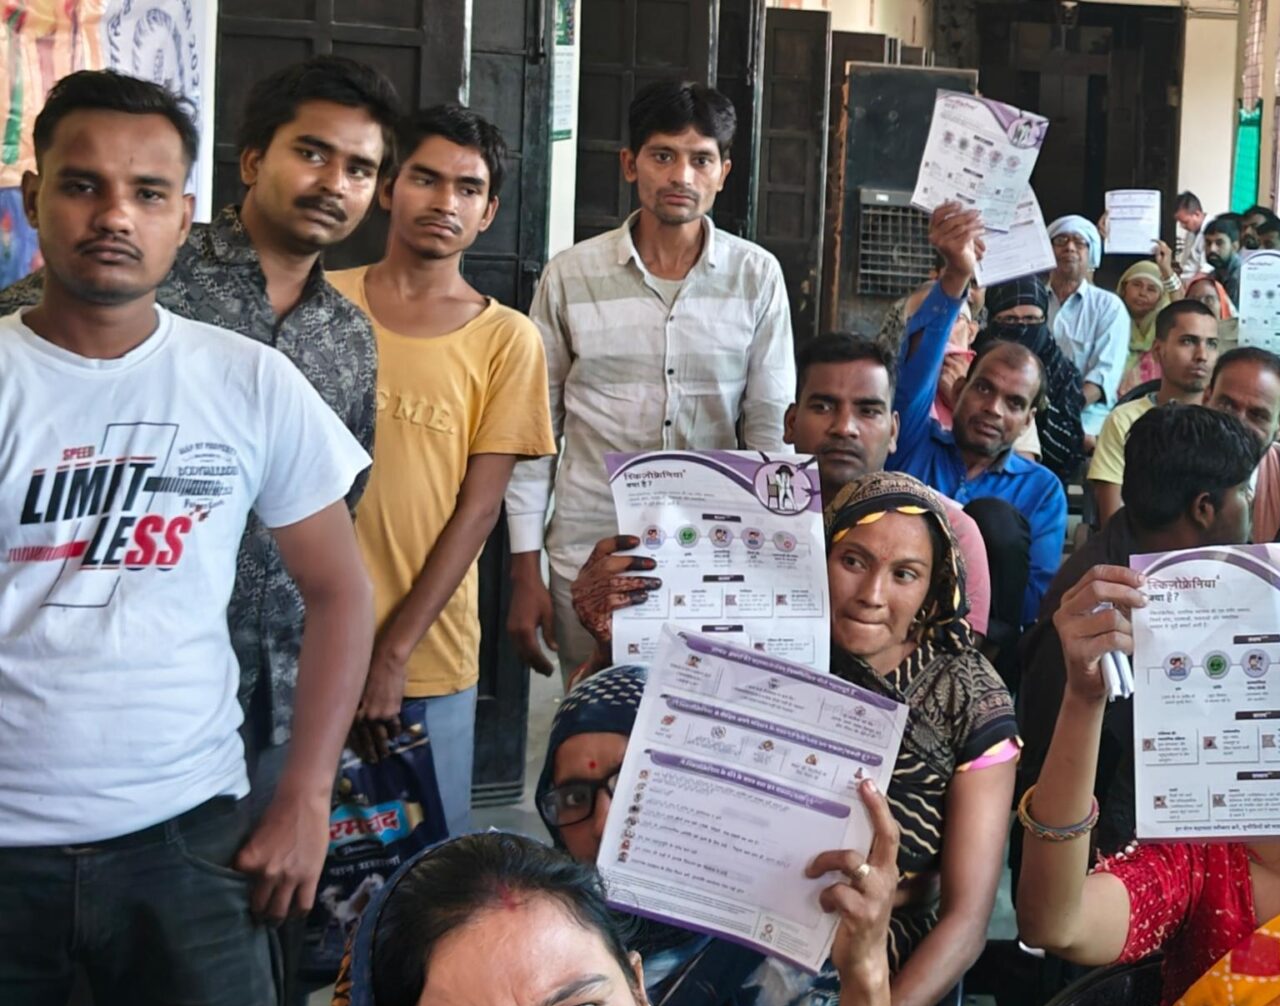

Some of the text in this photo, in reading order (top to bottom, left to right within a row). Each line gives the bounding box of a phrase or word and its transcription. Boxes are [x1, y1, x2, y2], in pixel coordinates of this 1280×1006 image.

[62, 446, 95, 461] SPEED
[20, 462, 155, 525] LIMIT
[80, 513, 192, 570] LESS
